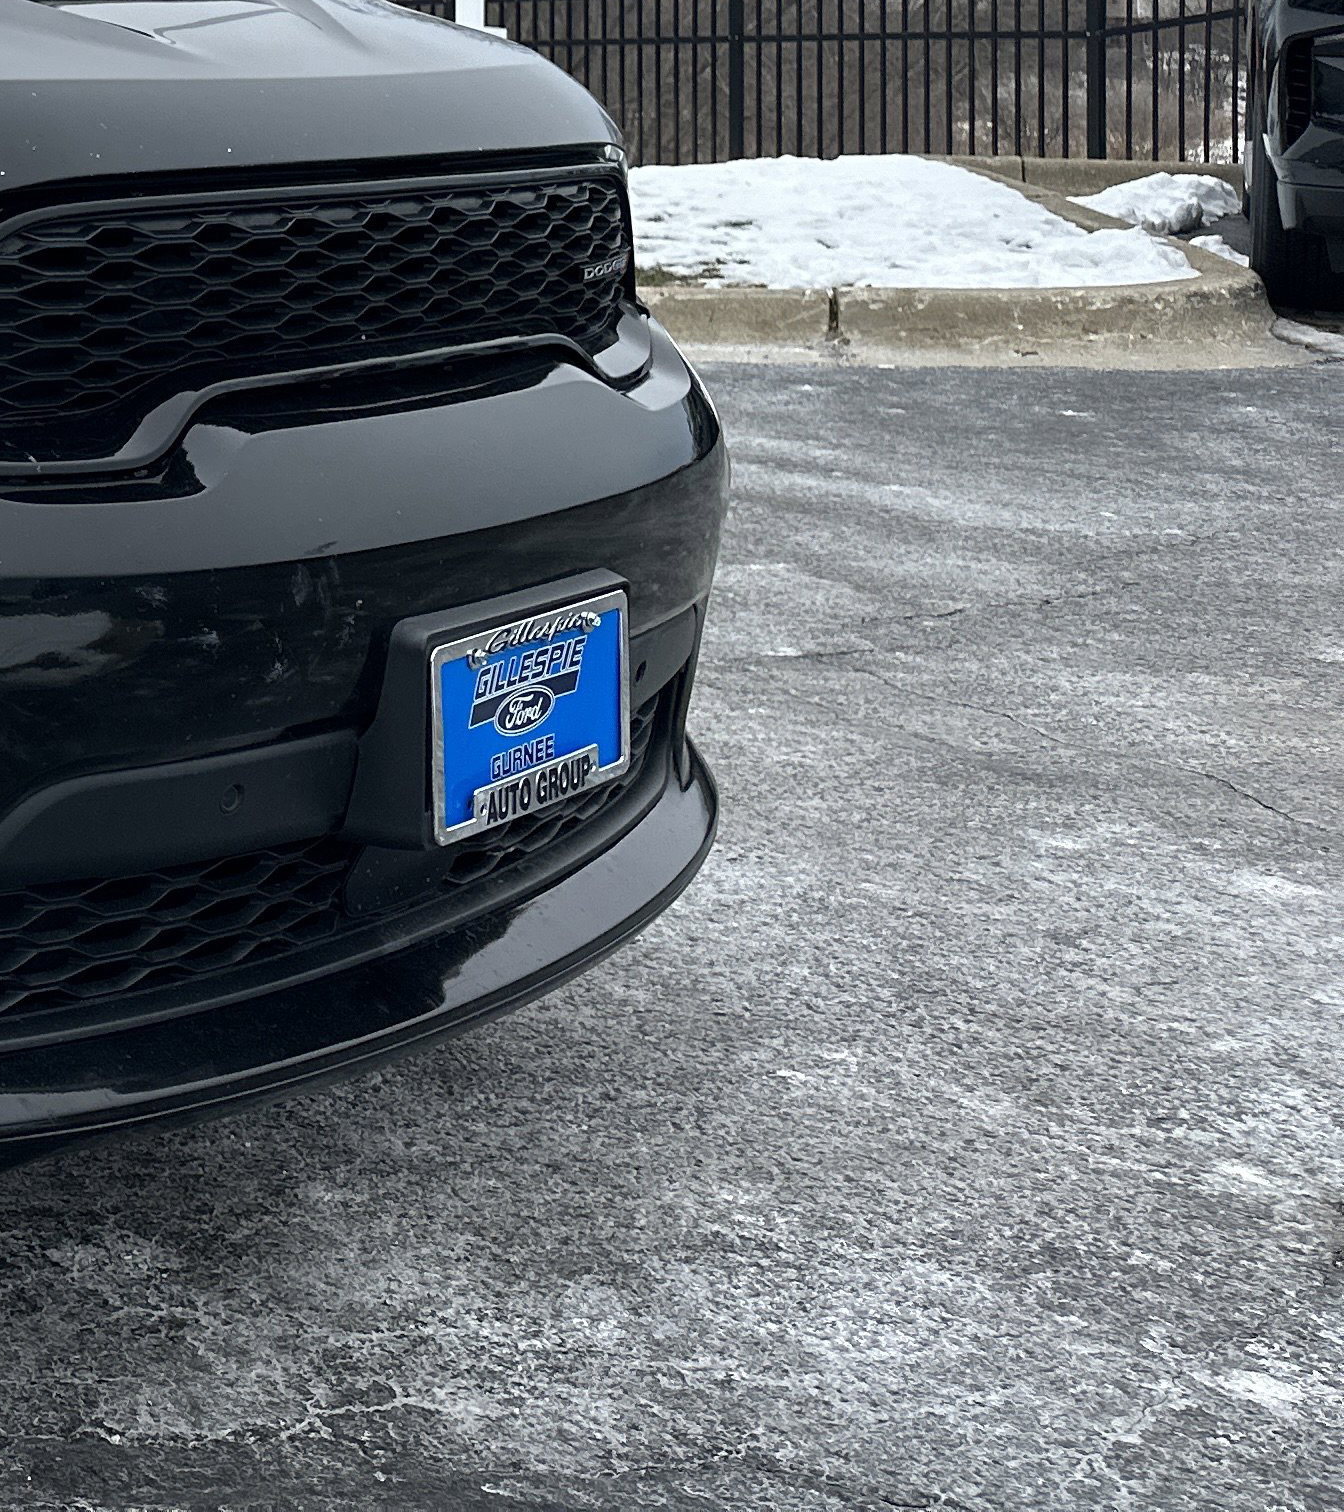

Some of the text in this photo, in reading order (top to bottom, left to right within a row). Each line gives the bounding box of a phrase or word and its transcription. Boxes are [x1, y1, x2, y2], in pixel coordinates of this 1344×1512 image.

[474, 635, 588, 702] GILLESPIE
[505, 695, 544, 729] Ford
[490, 734, 556, 781] GURNEE
[486, 754, 591, 826] AUTO GROUP
